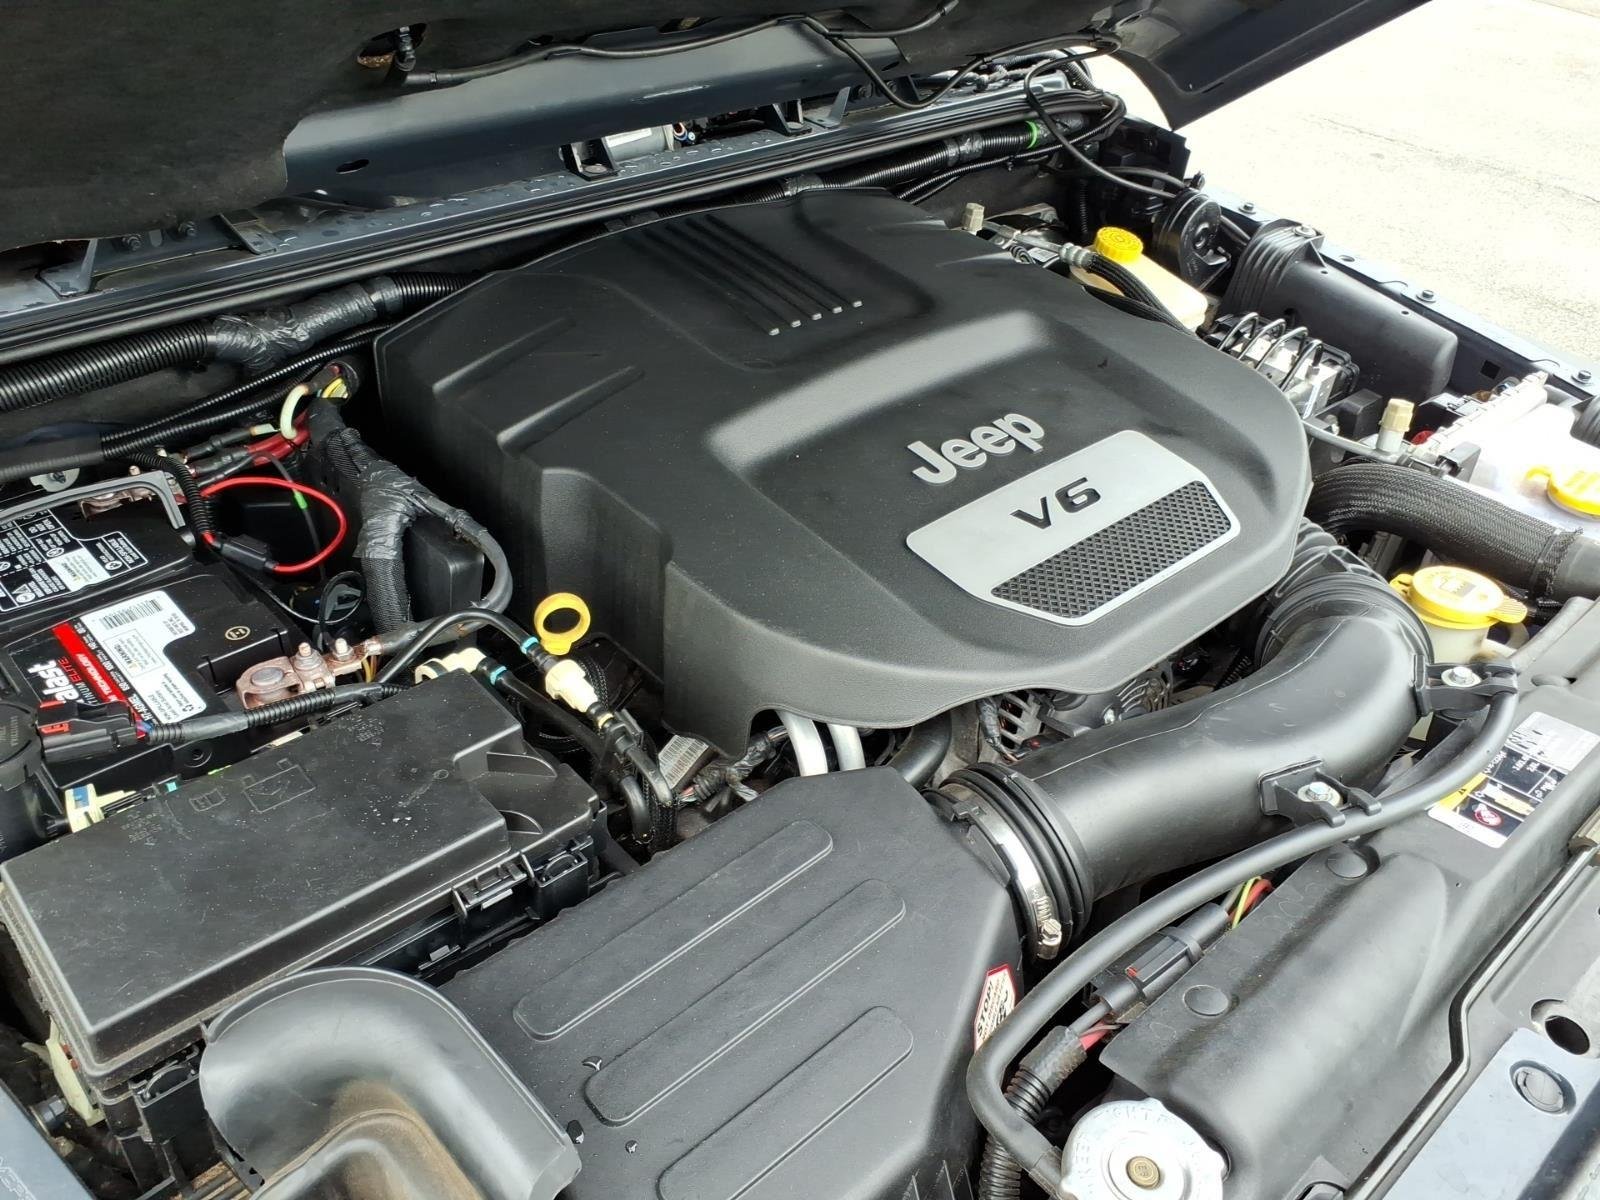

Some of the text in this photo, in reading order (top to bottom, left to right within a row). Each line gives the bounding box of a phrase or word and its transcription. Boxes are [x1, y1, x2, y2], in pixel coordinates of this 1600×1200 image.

[907, 413, 1045, 485] Jeep
[1010, 477, 1102, 530] V6
[57, 658, 82, 682] ELITE
[75, 654, 112, 694] TECHNOLOGY
